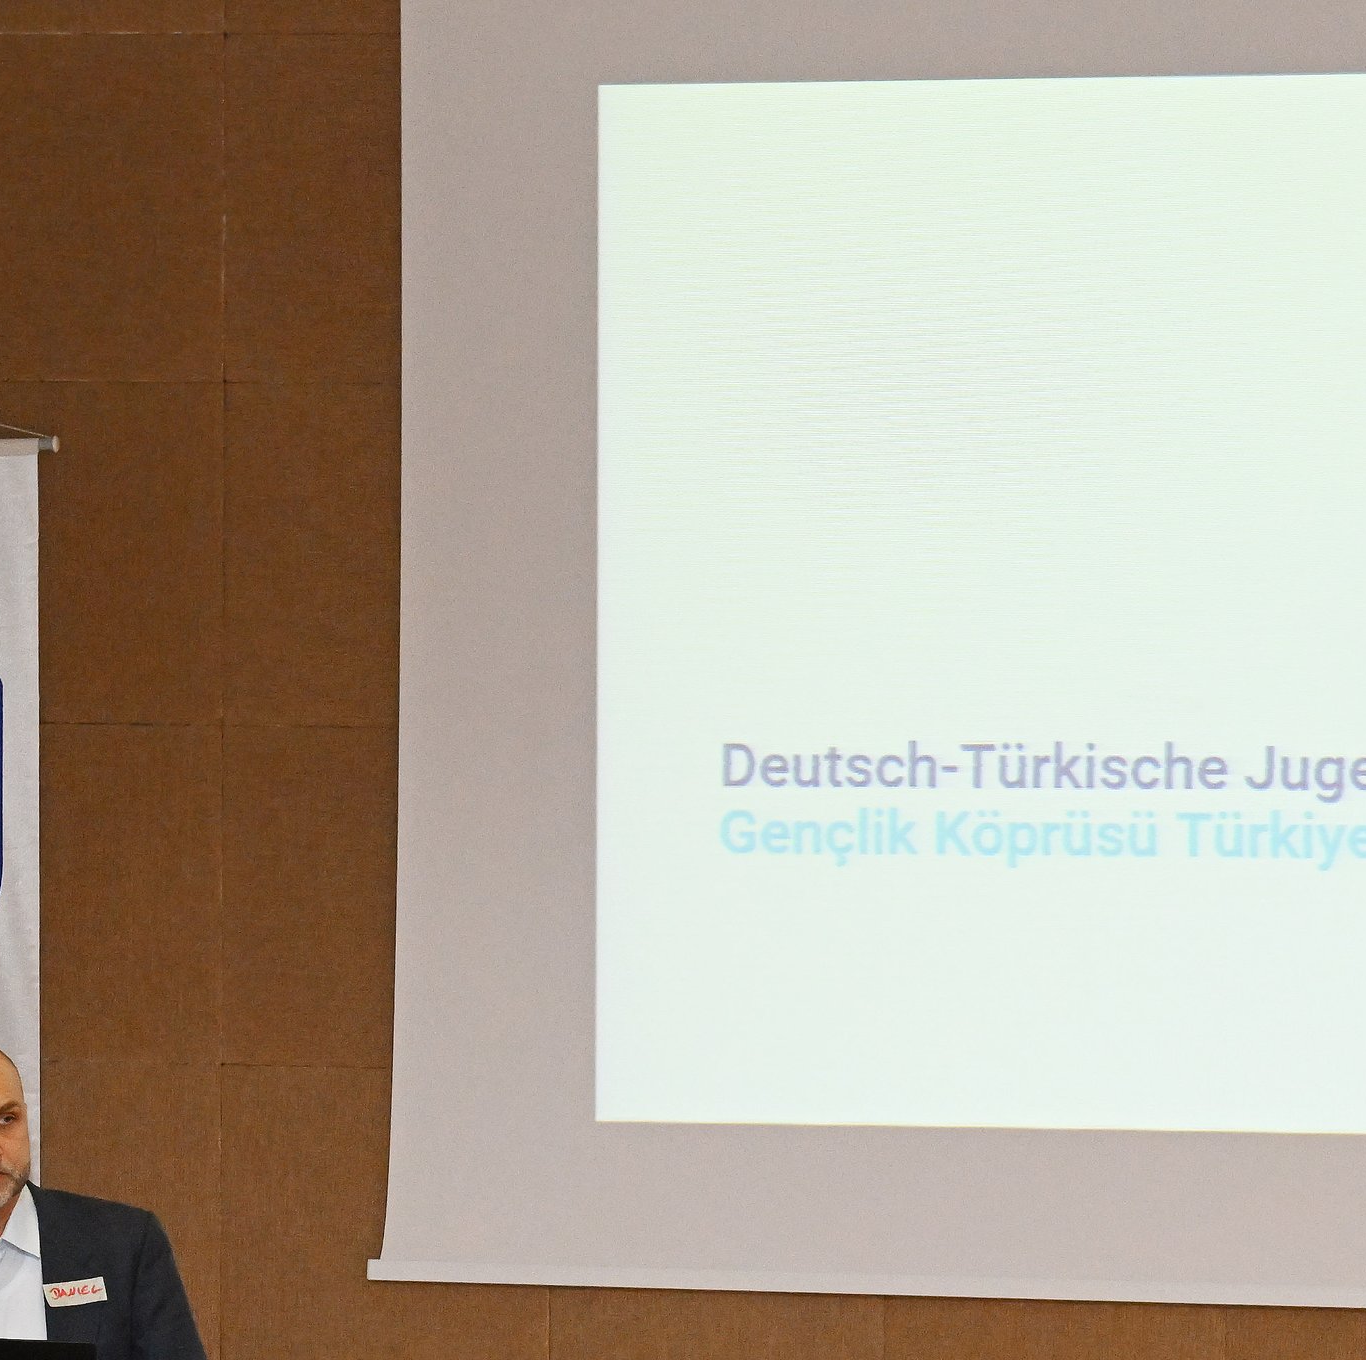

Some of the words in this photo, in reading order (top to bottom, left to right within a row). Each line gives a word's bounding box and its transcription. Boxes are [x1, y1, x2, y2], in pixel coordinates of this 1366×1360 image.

[721, 740, 1228, 790] Deutsch-Türkische
[719, 806, 919, 866] Gençlik
[934, 811, 1159, 867] Köprüsü
